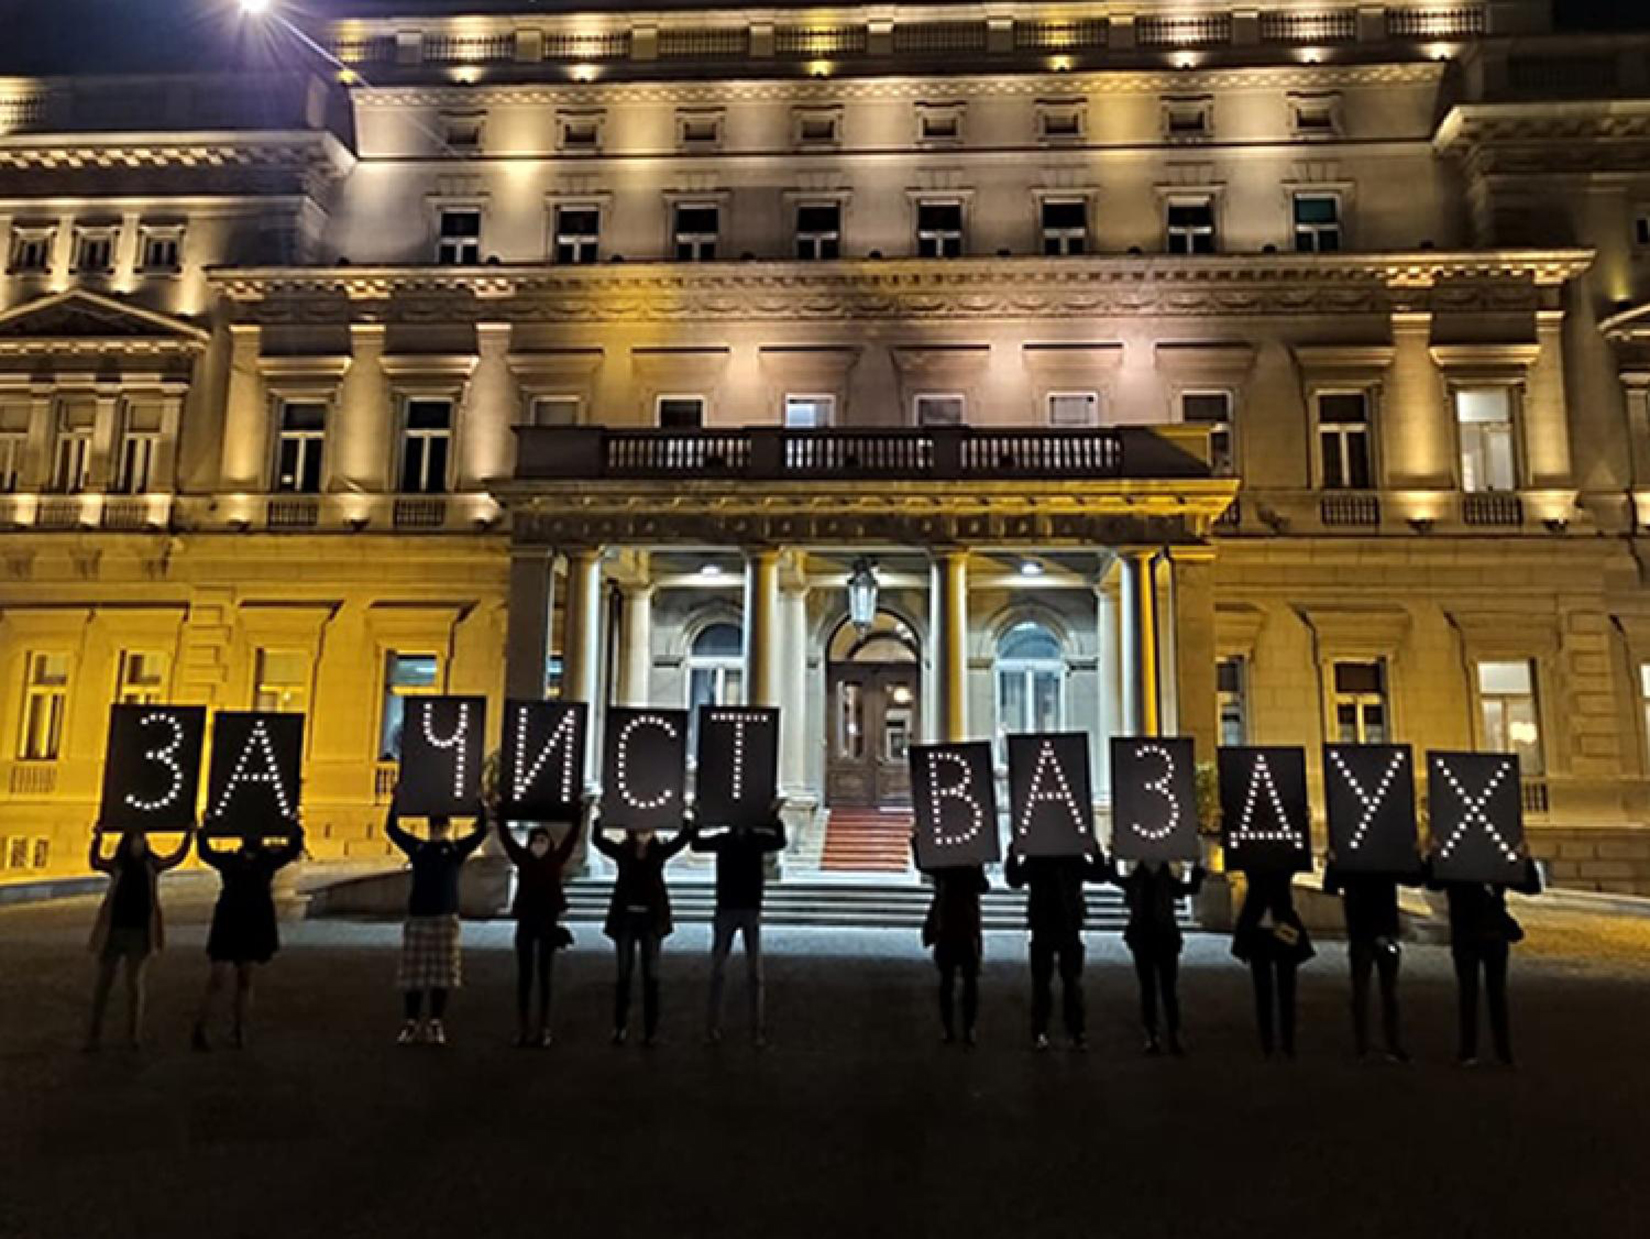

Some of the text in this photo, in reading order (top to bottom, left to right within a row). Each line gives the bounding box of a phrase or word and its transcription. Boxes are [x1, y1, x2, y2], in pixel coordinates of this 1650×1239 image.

[125, 703, 1519, 861] ЗА ЧИСТ ВАЗДУХ
